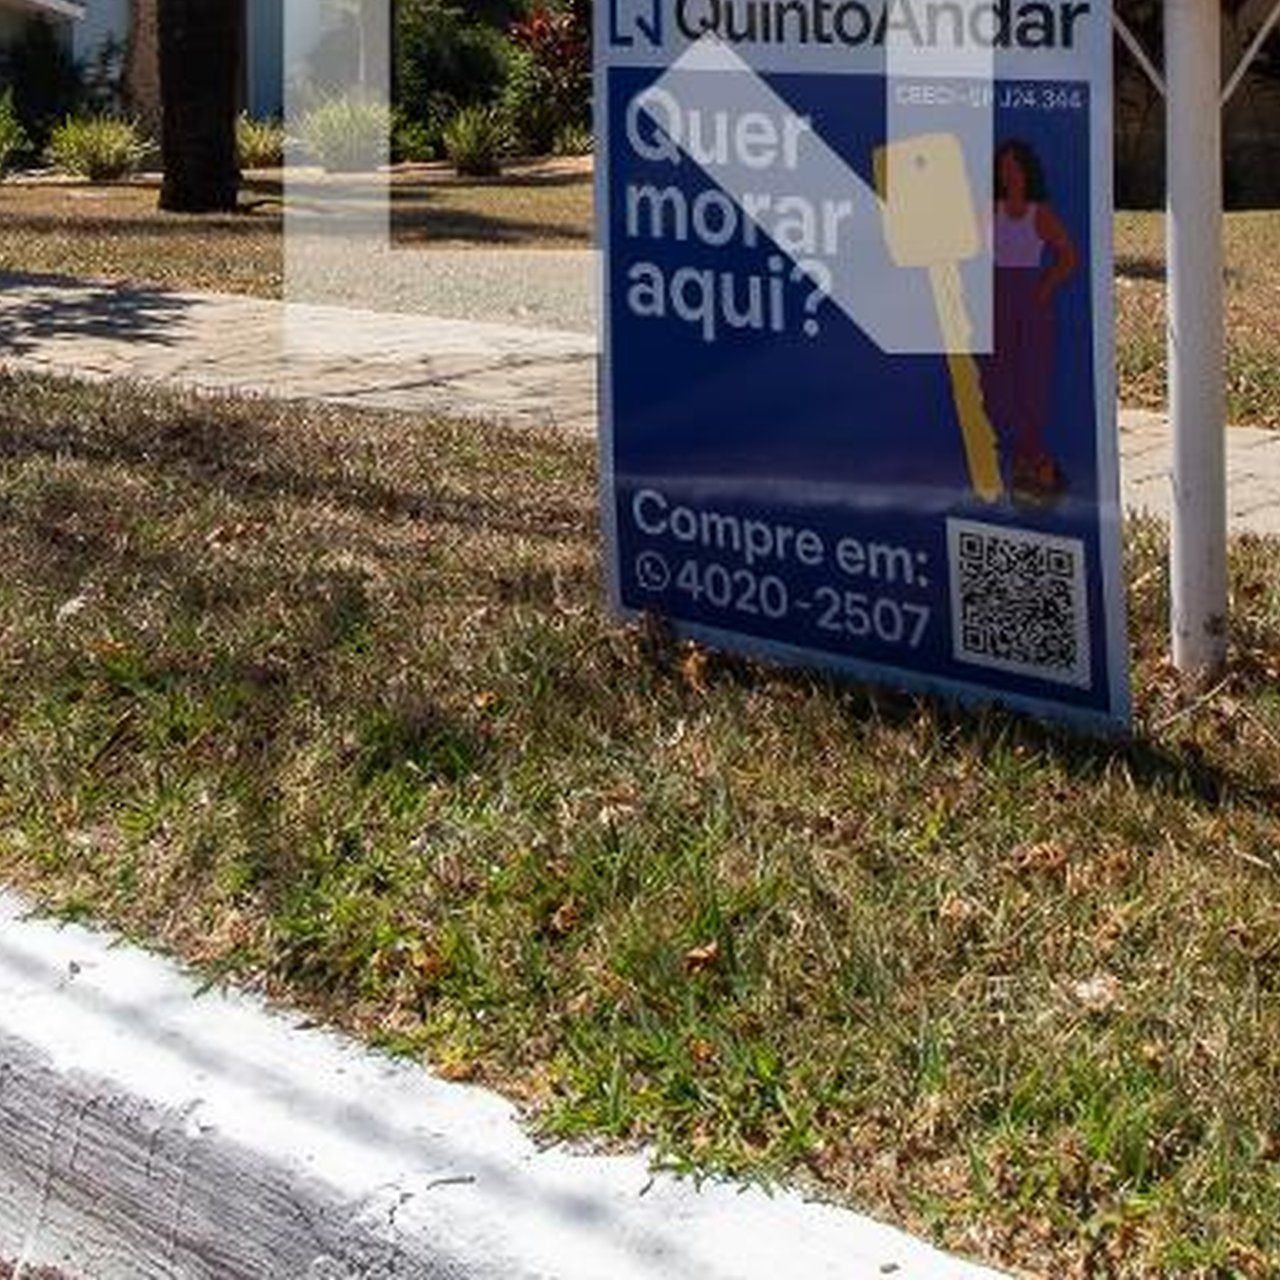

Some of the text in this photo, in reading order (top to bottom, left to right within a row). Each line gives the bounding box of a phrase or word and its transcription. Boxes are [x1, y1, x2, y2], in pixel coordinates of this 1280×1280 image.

[625, 87, 810, 169] Quer
[626, 183, 852, 255] morar
[627, 258, 832, 342] aqui?
[632, 489, 930, 587] Compre em:
